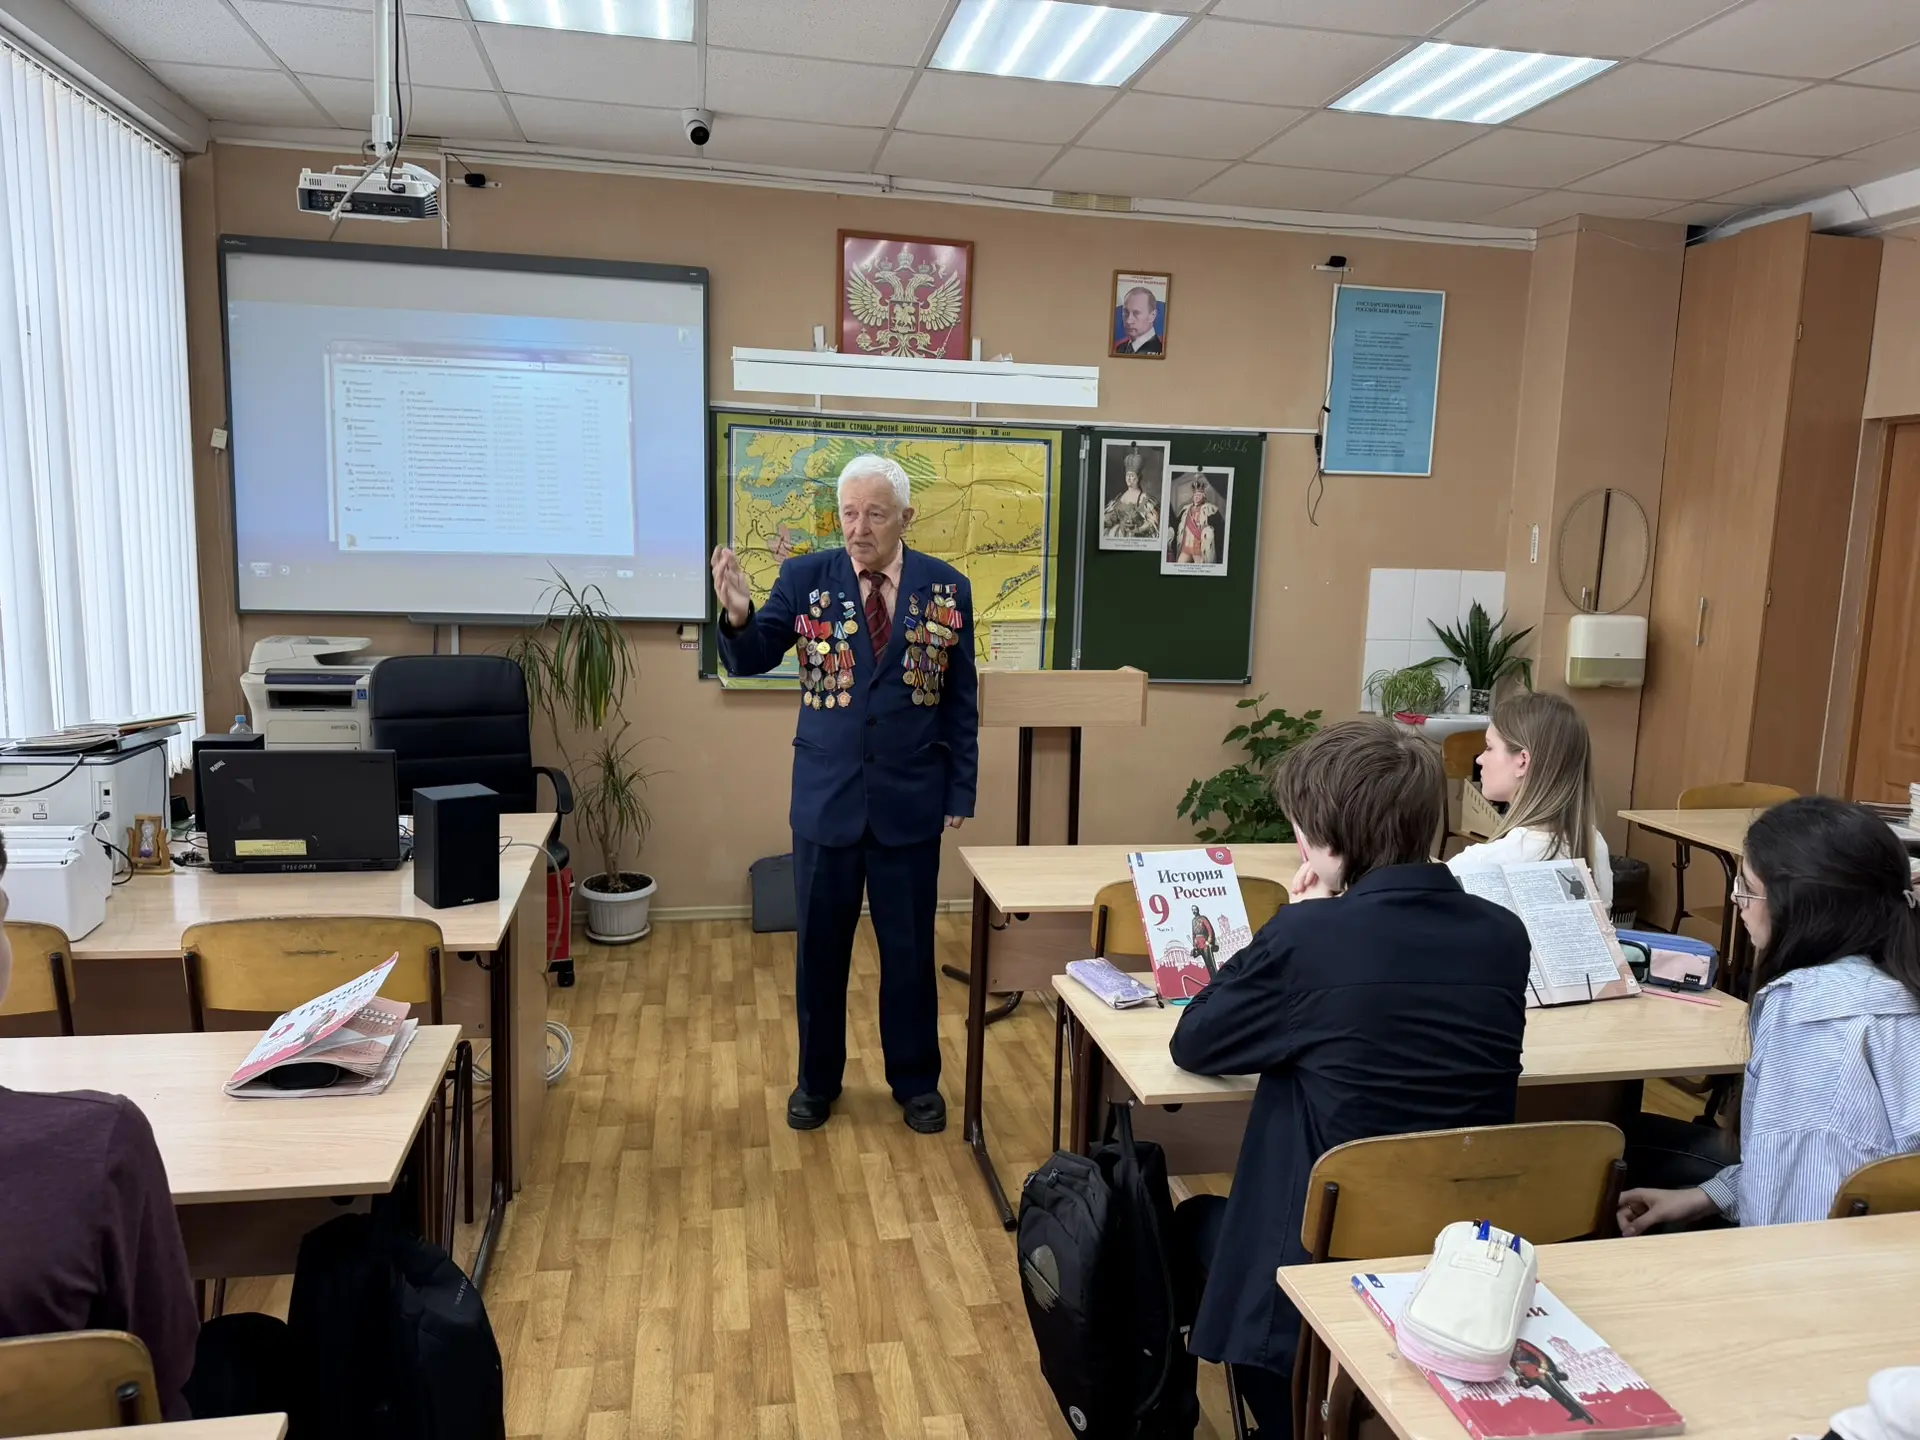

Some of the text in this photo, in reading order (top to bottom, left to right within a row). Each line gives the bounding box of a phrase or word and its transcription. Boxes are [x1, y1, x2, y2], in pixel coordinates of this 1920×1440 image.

[769, 417, 793, 426] БОРЬБА
[849, 422, 873, 431] СТРАНЫ
[902, 424, 938, 434] ИНОЗЕМНЫХ
[941, 426, 978, 436] ЗАХВАТЧИКОВ
[1157, 869, 1224, 884] История
[1173, 886, 1228, 900] России
[1148, 894, 1170, 926] 9
